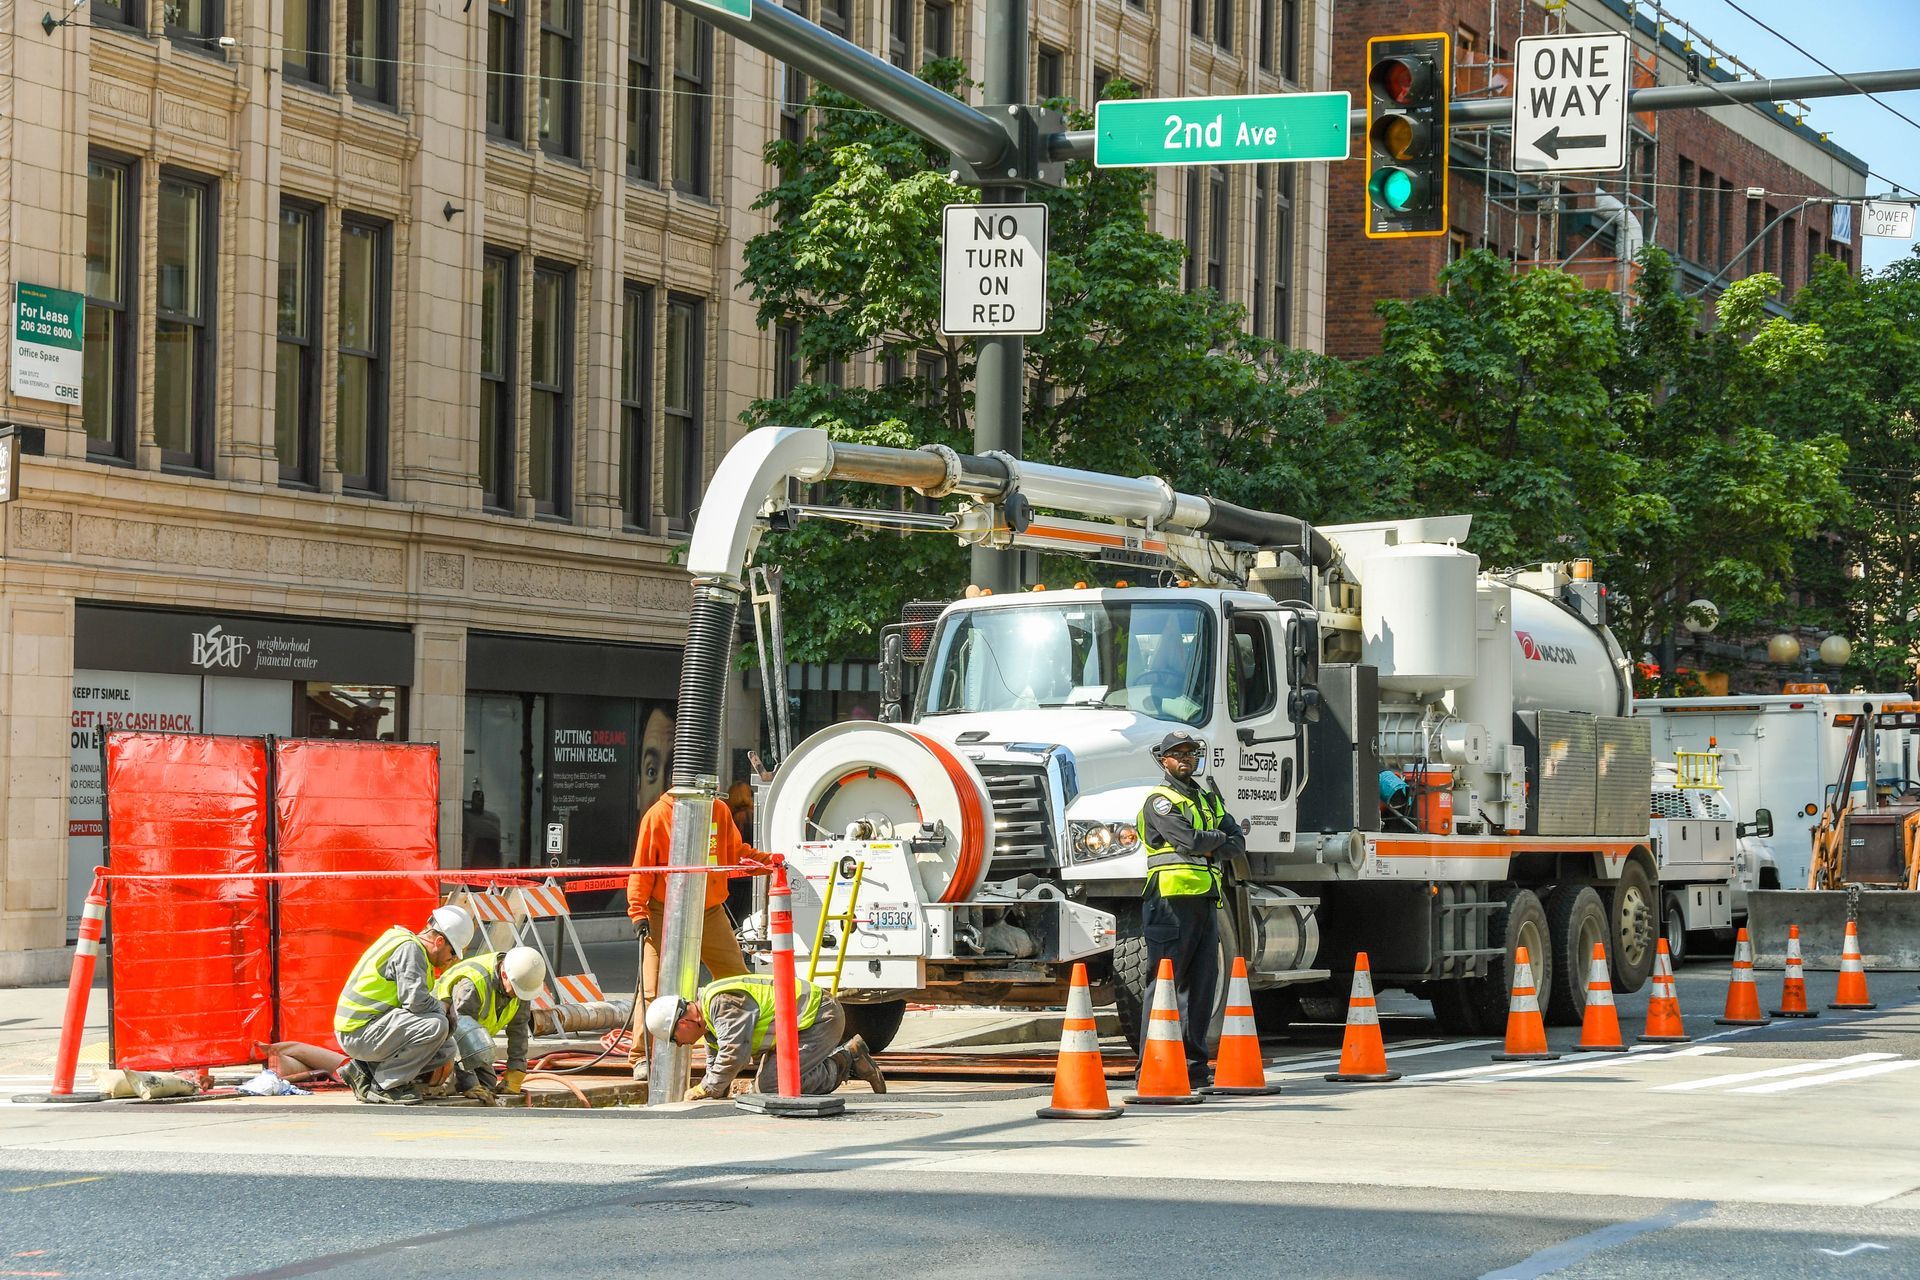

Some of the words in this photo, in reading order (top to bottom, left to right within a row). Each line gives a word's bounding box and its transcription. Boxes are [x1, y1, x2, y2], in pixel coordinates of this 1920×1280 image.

[1534, 46, 1608, 80] ONE
[1530, 84, 1611, 118] WAY
[1164, 113, 1222, 149] 2nd
[1235, 121, 1277, 147] Ave
[1869, 209, 1908, 222] POWER
[974, 215, 1017, 240] NO
[1877, 224, 1896, 235] OFF
[965, 249, 1023, 268] TURN
[979, 276, 1008, 295] ON
[21, 302, 37, 318] For
[40, 306, 69, 324] Lease
[972, 304, 1015, 323] RED
[21, 320, 35, 332] 206
[37, 323, 51, 335] 292
[53, 326, 72, 339] 6000
[19, 346, 38, 359] Office
[39, 350, 60, 363] Space
[55, 385, 79, 399] CBRE
[191, 625, 251, 668] BECU
[257, 635, 311, 654] neighborhood
[254, 652, 292, 670] financial
[293, 657, 318, 669] center
[92, 688, 100, 699] IT
[101, 688, 131, 700] SIMPLE.
[72, 710, 94, 728] GET
[97, 711, 123, 729] 15%
[125, 712, 157, 730] CASH
[160, 714, 194, 731] BACK.
[71, 731, 88, 749] ON
[554, 729, 591, 744] PUTTING
[593, 730, 626, 745] DREAMS
[554, 747, 585, 762] WITHIN
[587, 748, 617, 762] REACH.
[1214, 748, 1224, 757] ET
[1239, 747, 1277, 773] LineScape
[80, 764, 101, 773] ANNUA
[80, 780, 101, 789] FOREIG
[79, 796, 94, 805] CASH
[1238, 789, 1277, 801] 206-794-6040
[70, 823, 88, 832] APPLY
[89, 824, 103, 832] TOD
[868, 911, 913, 926] C19536K
